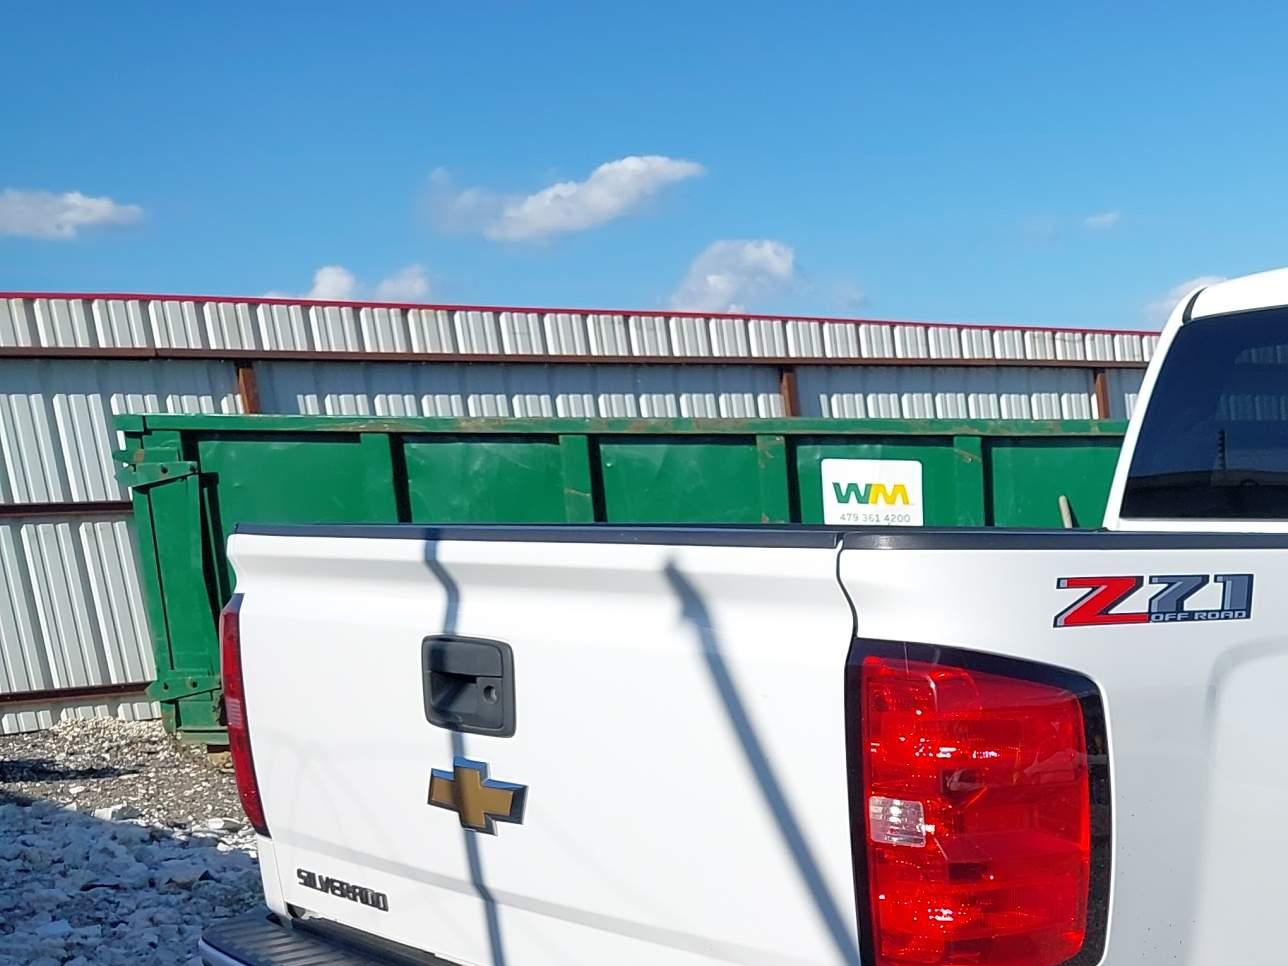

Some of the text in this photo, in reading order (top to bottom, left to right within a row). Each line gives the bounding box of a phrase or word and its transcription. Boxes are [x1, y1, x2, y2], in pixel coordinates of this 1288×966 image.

[832, 482, 910, 505] WM
[884, 513, 911, 523] 4200
[1054, 573, 1254, 628] Z71
[1150, 609, 1247, 622] OFF ROAD
